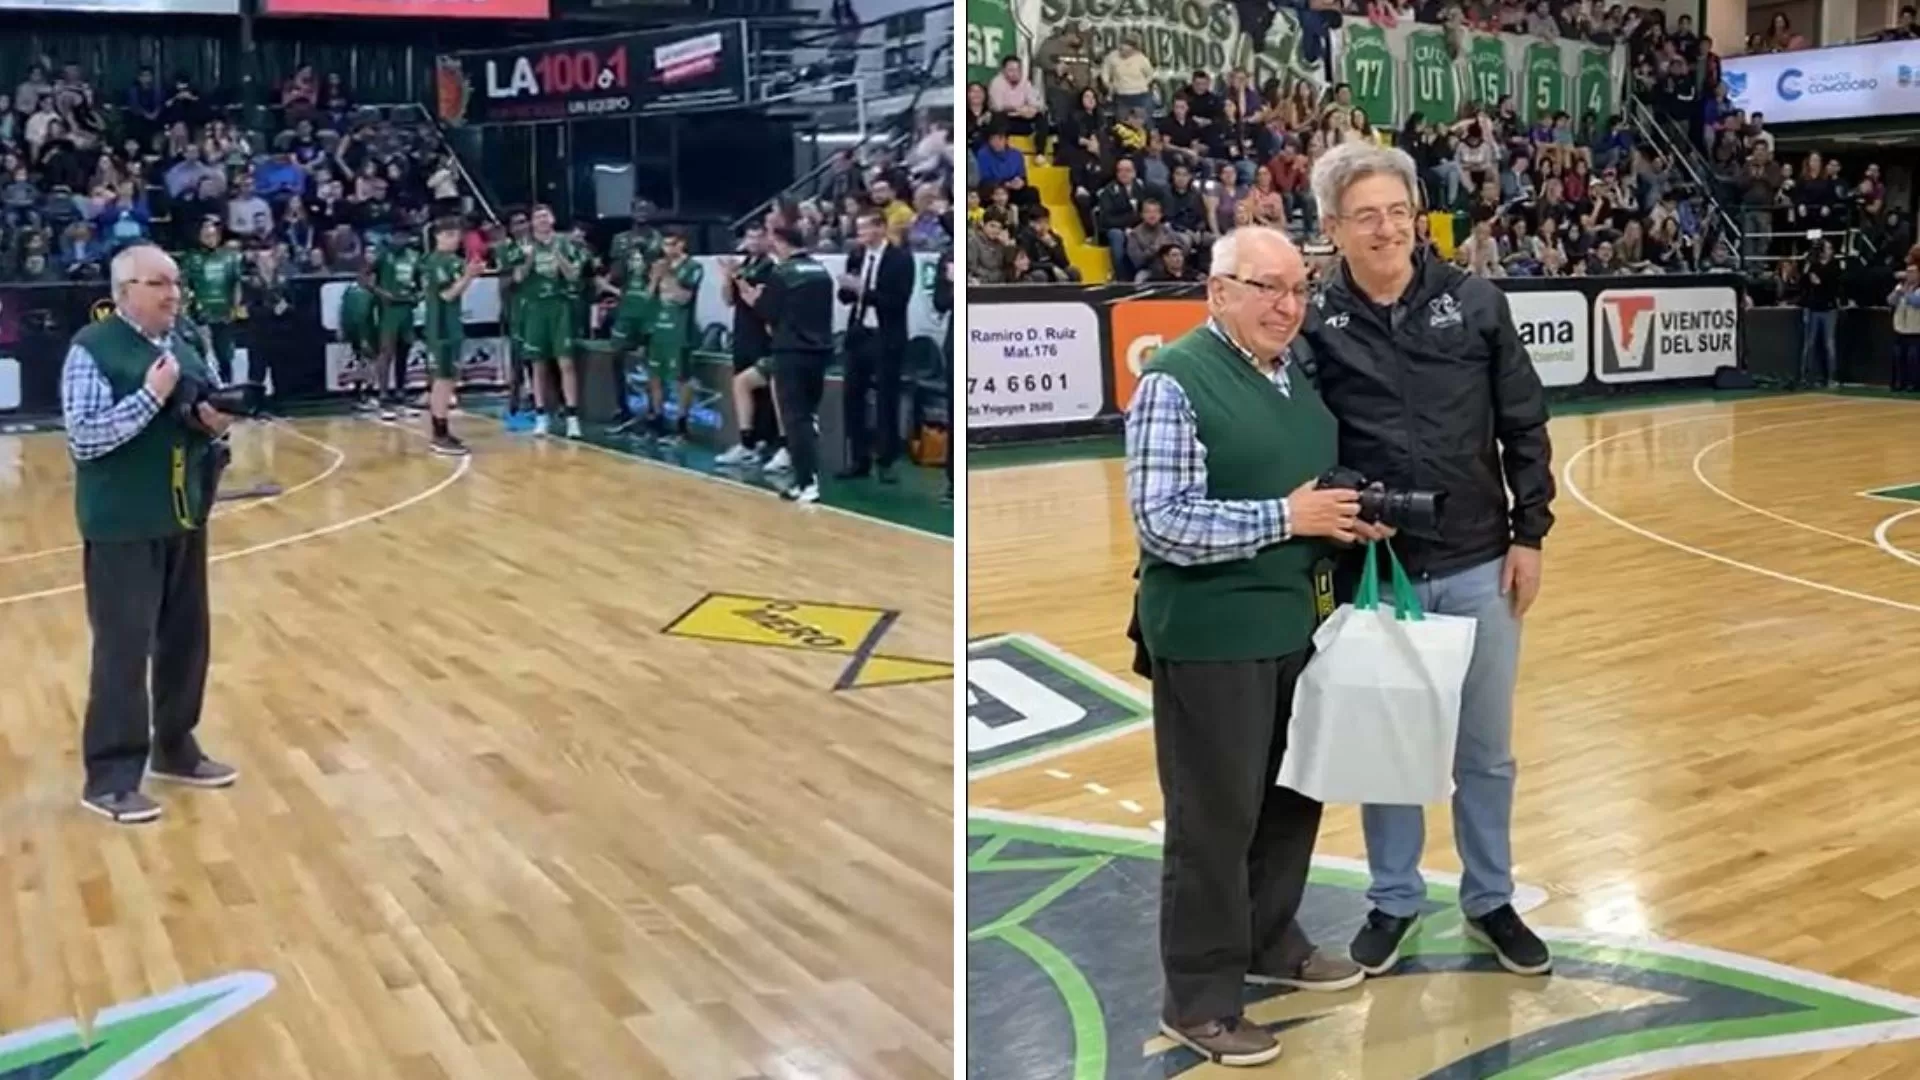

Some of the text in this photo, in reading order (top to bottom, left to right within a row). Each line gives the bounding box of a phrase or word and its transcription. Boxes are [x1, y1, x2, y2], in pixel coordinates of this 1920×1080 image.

[1355, 59, 1383, 97] 77
[1418, 66, 1444, 101] UT
[1479, 71, 1499, 105] 15
[1537, 76, 1551, 108] 5
[1589, 82, 1600, 114] 4
[971, 326, 1077, 342] Ramiro D. Ruiz
[1519, 320, 1574, 345] ana
[1660, 309, 1735, 331] VIENTOS
[1003, 343, 1058, 358] Mat.176
[1661, 332, 1732, 355] DEL SUR
